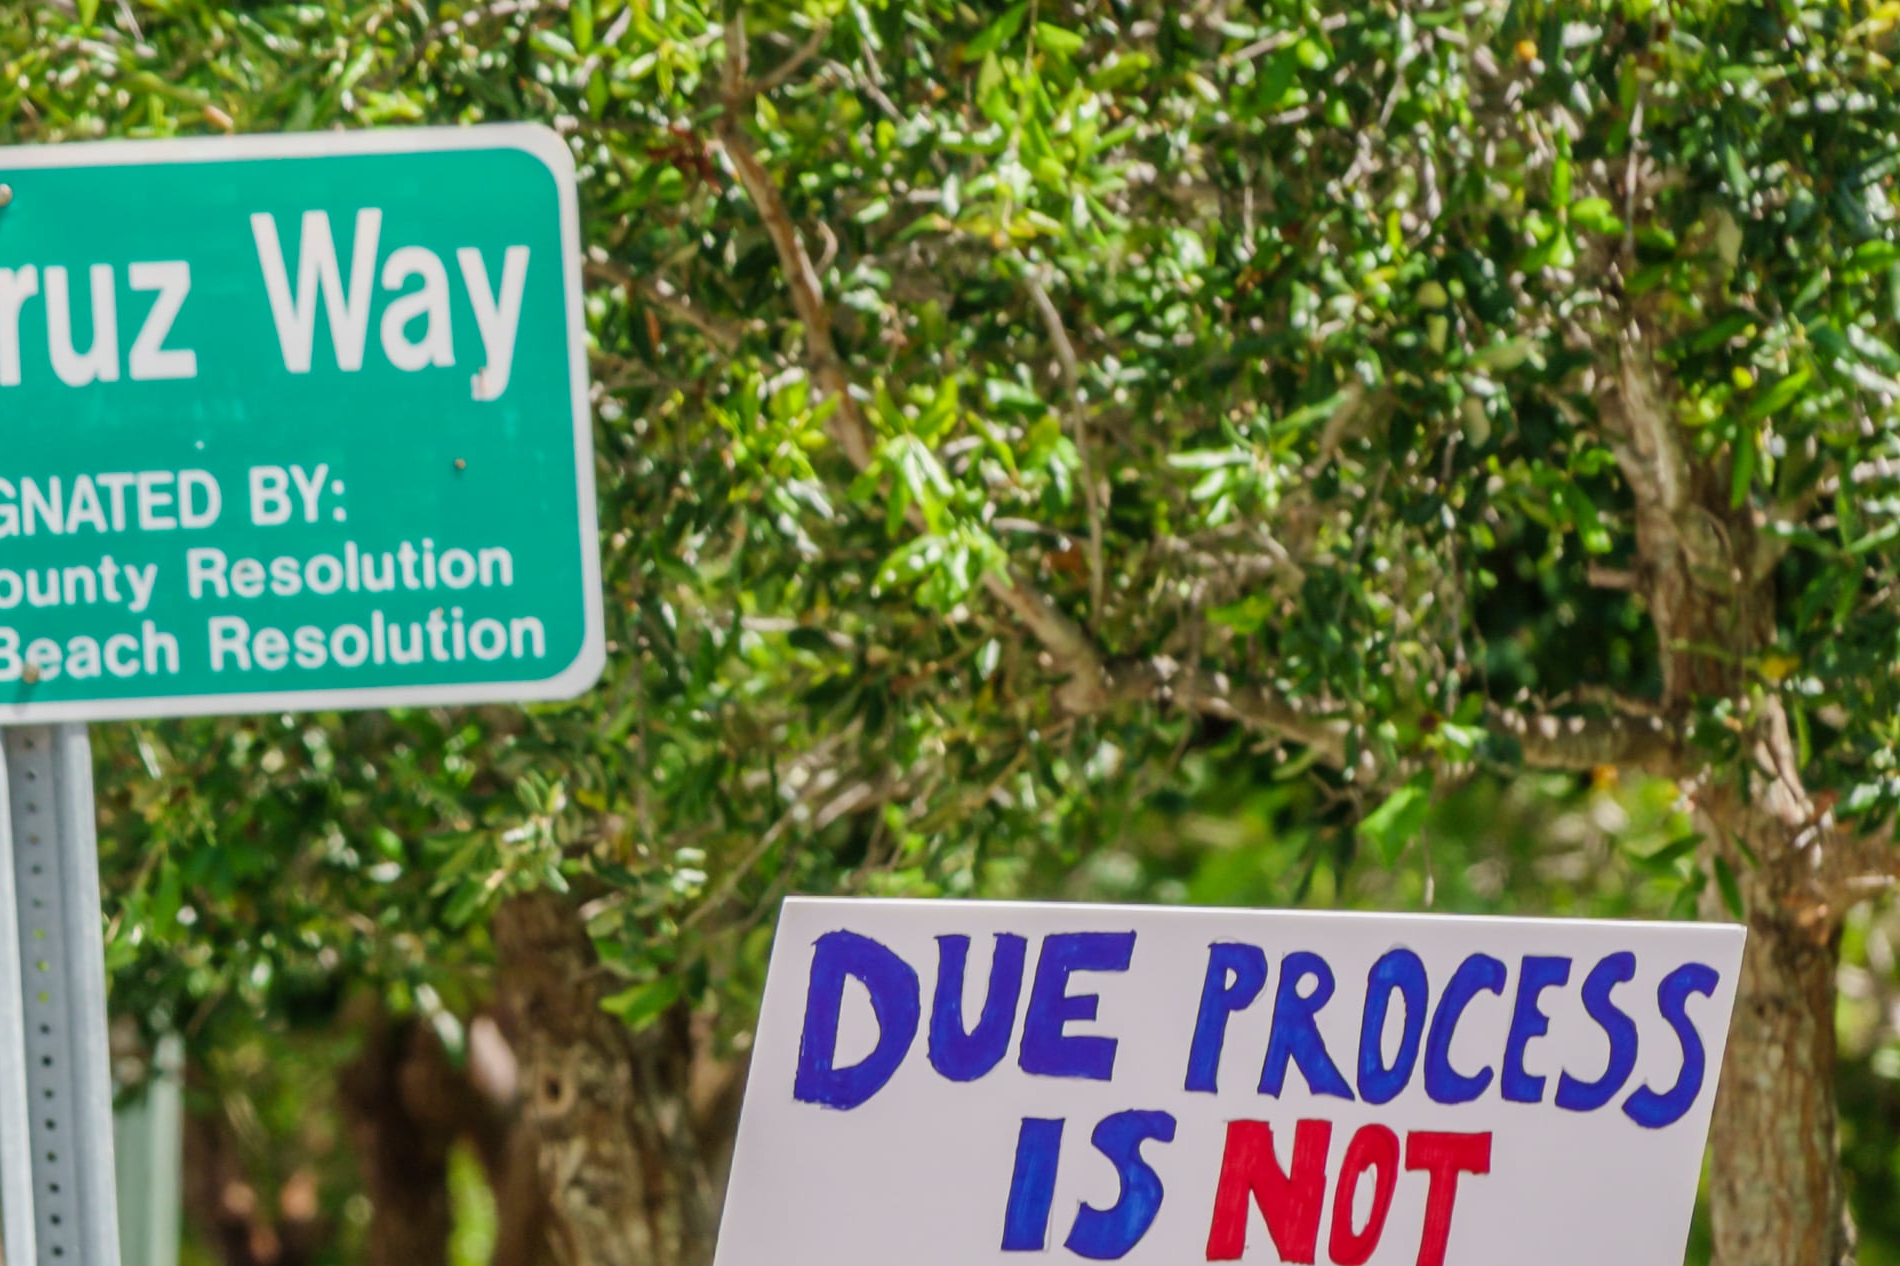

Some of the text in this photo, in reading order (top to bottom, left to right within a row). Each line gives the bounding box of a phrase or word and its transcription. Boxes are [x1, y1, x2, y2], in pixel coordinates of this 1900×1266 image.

[250, 207, 530, 401] Way
[249, 464, 346, 525] BY:
[187, 541, 513, 600] Resolution
[209, 611, 545, 671] Resolution
[794, 929, 1720, 1129] DUE PROCESS
[1000, 1108, 1177, 1261] IS
